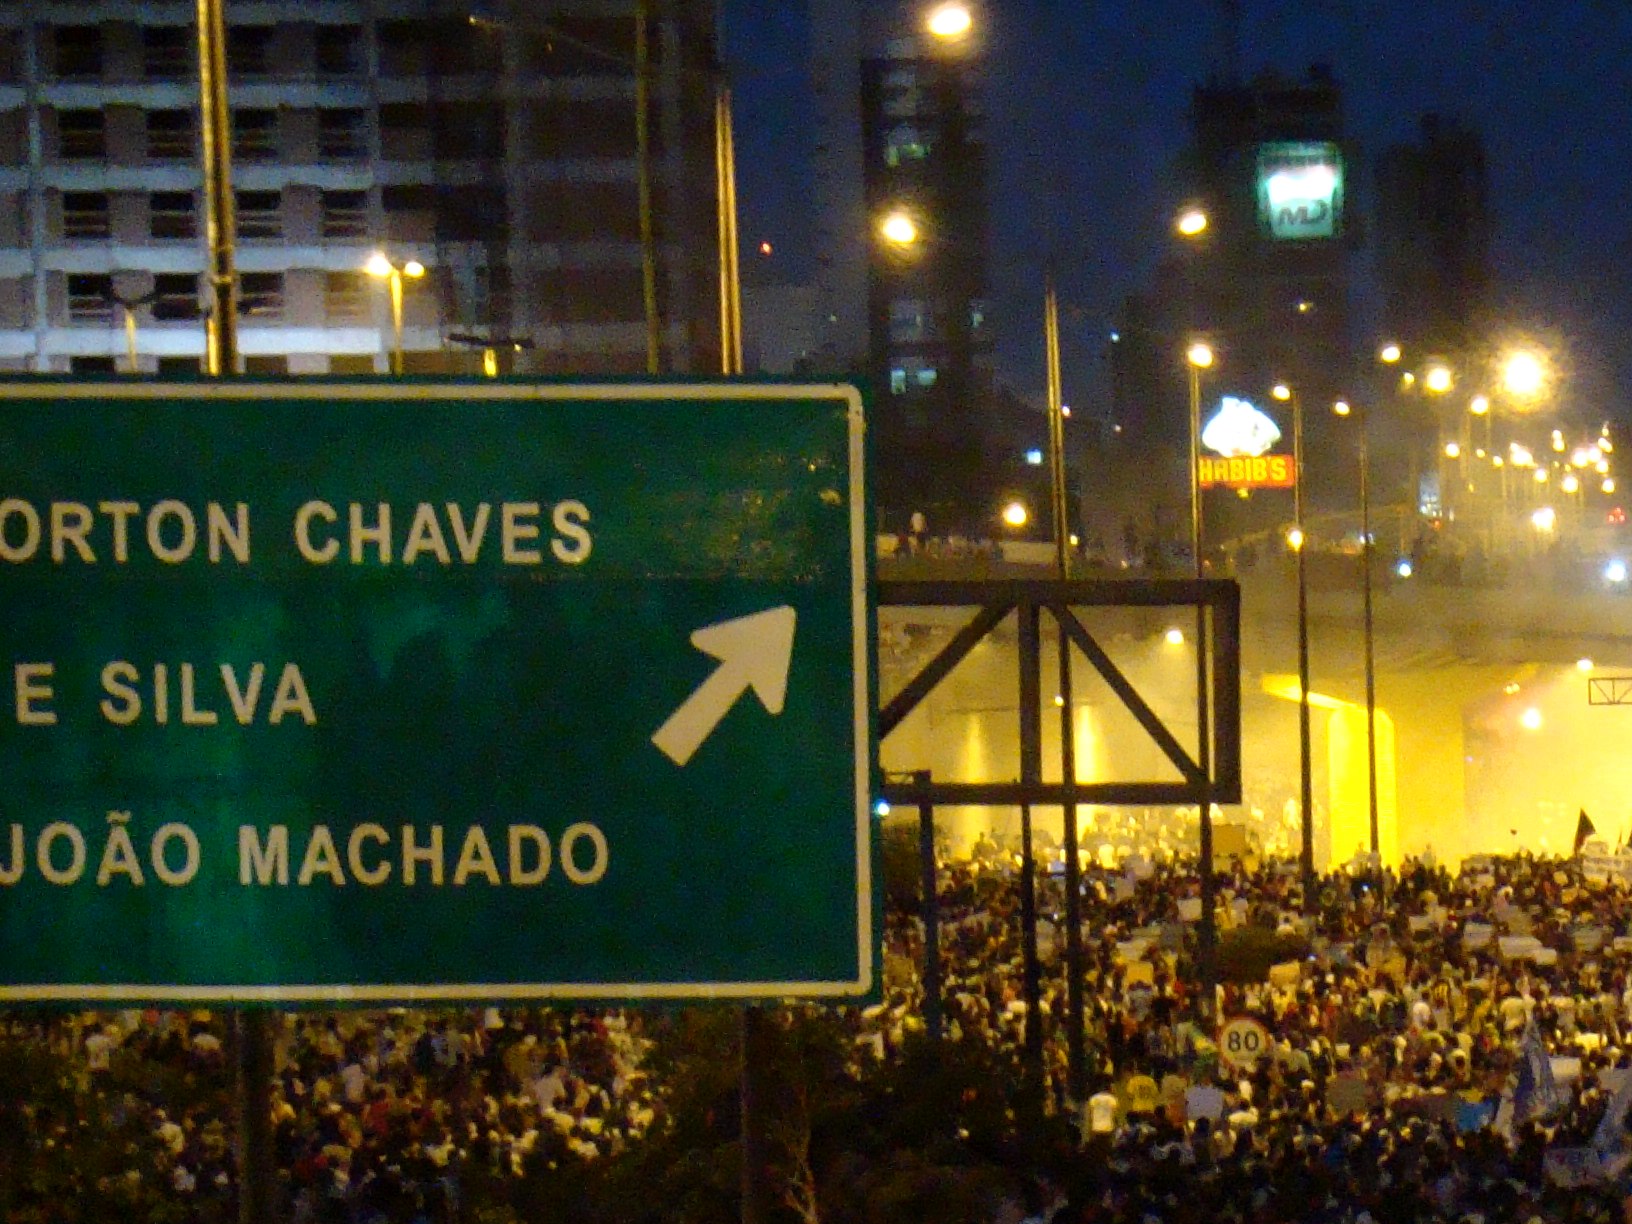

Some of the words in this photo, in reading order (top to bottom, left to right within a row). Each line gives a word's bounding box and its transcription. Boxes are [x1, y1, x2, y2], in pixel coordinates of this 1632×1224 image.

[1199, 458, 1286, 481] HABIB'S
[295, 499, 594, 566] CHAVES
[16, 663, 56, 724] E
[101, 662, 316, 725] SILVA
[0, 811, 201, 886] JOÃO
[239, 822, 609, 886] MACHADO
[1228, 1030, 1259, 1052] 80
